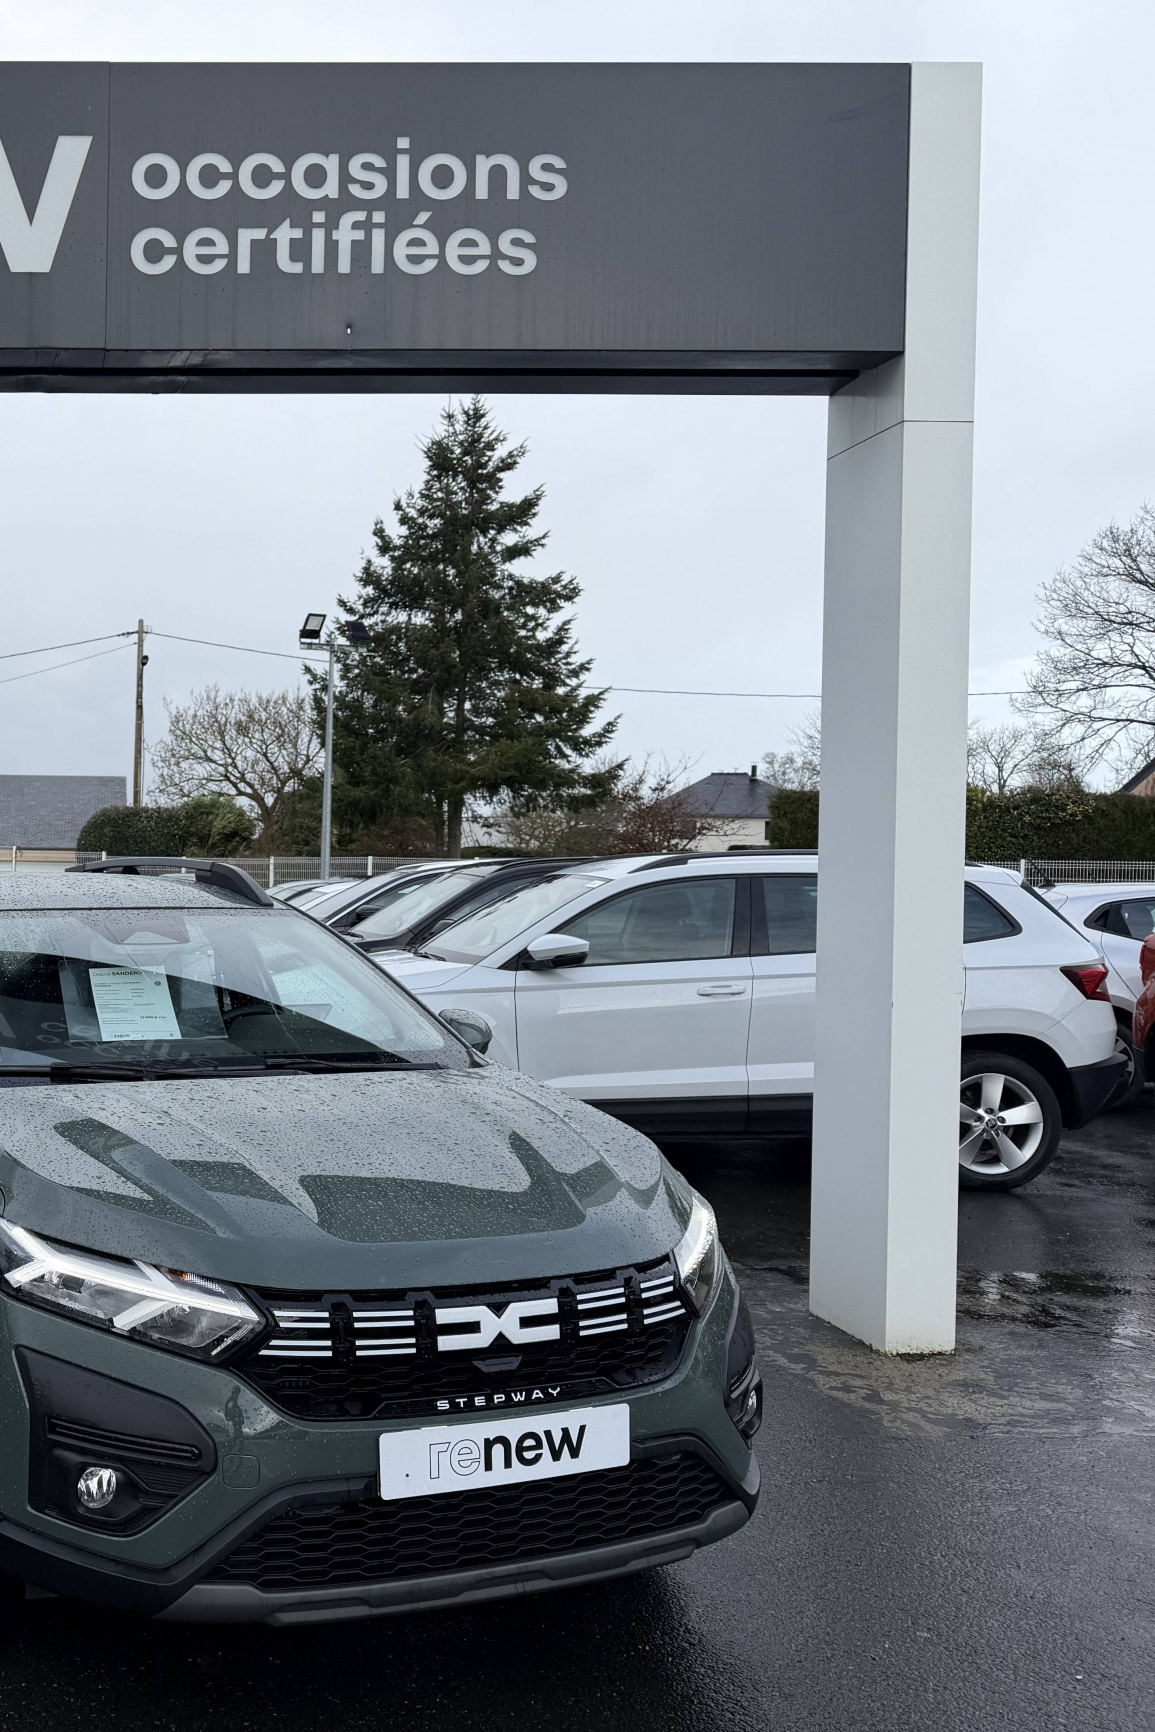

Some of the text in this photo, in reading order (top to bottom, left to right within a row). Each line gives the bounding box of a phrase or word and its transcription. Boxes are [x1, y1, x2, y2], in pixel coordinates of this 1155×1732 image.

[132, 137, 567, 200] occasions
[131, 211, 537, 275] certifiées
[437, 1386, 561, 1410] STEPWAY
[429, 1424, 587, 1479] renew
